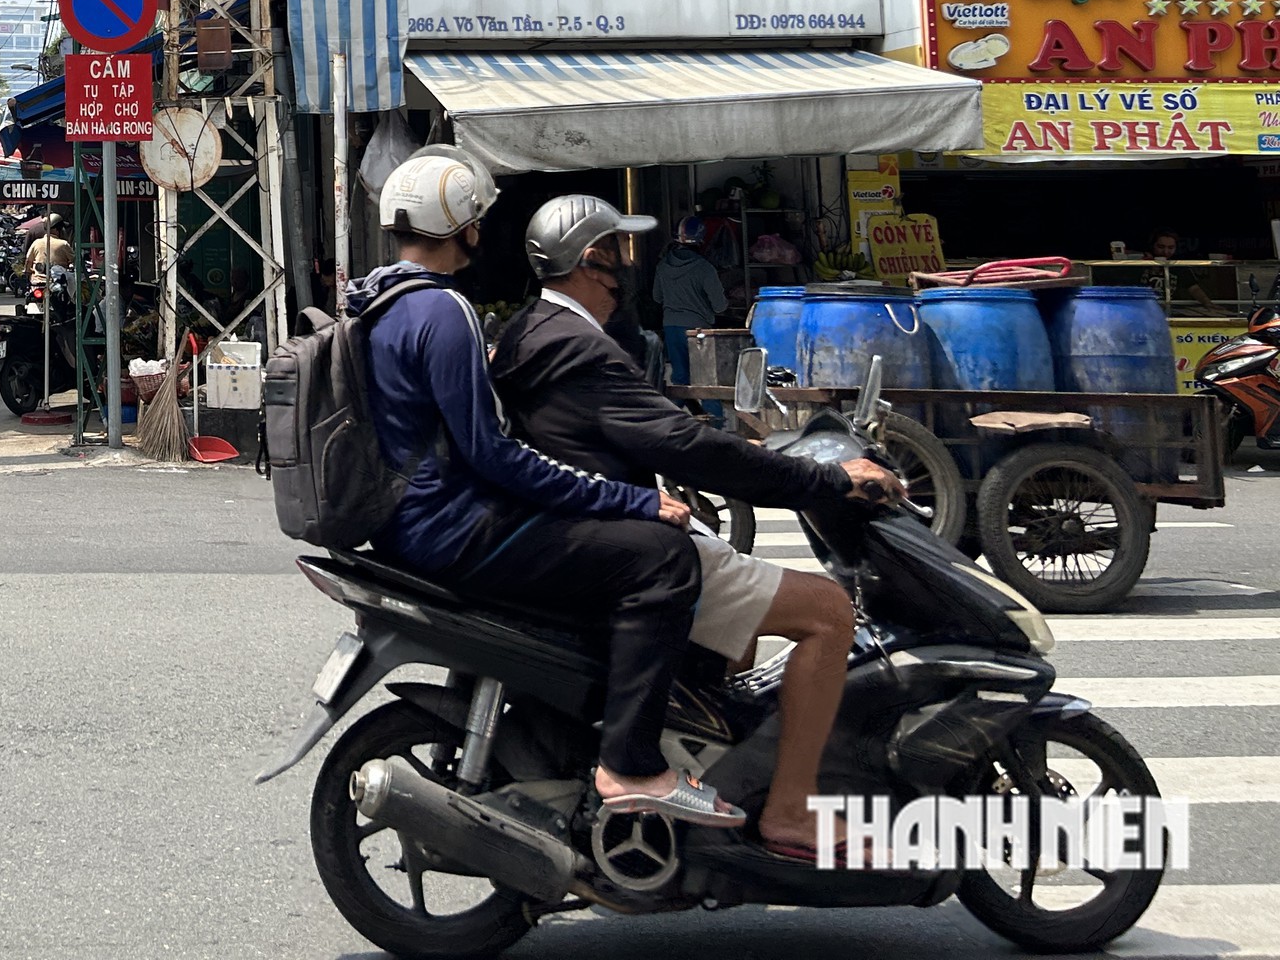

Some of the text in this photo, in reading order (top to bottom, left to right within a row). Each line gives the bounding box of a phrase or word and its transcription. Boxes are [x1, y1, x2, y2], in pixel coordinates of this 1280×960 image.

[947, 5, 1007, 18] Vietlott
[408, 17, 434, 32] 266
[436, 17, 450, 32] A
[453, 16, 473, 32] Võ
[476, 16, 508, 32] Văn
[512, 13, 543, 32] Tần
[557, 16, 582, 31] P.5
[735, 14, 865, 30] DĐ: 0978 664 944
[1027, 19, 1160, 72] AN
[90, 55, 131, 79] CẤM
[84, 82, 135, 100] TỤ TẬP
[1024, 86, 1199, 115] ĐẠI LÝ VÉ SỐ
[80, 102, 139, 118] HỢP CHỢ
[66, 118, 152, 136] BÁN HÀNG RONG
[1002, 112, 1232, 152] AN PHÁT
[3, 183, 60, 199] CHIN-SU
[873, 221, 907, 244] CÒN
[911, 219, 934, 243] VÉ
[879, 248, 919, 274] CHIỀU
[1176, 333, 1193, 343] SỐ
